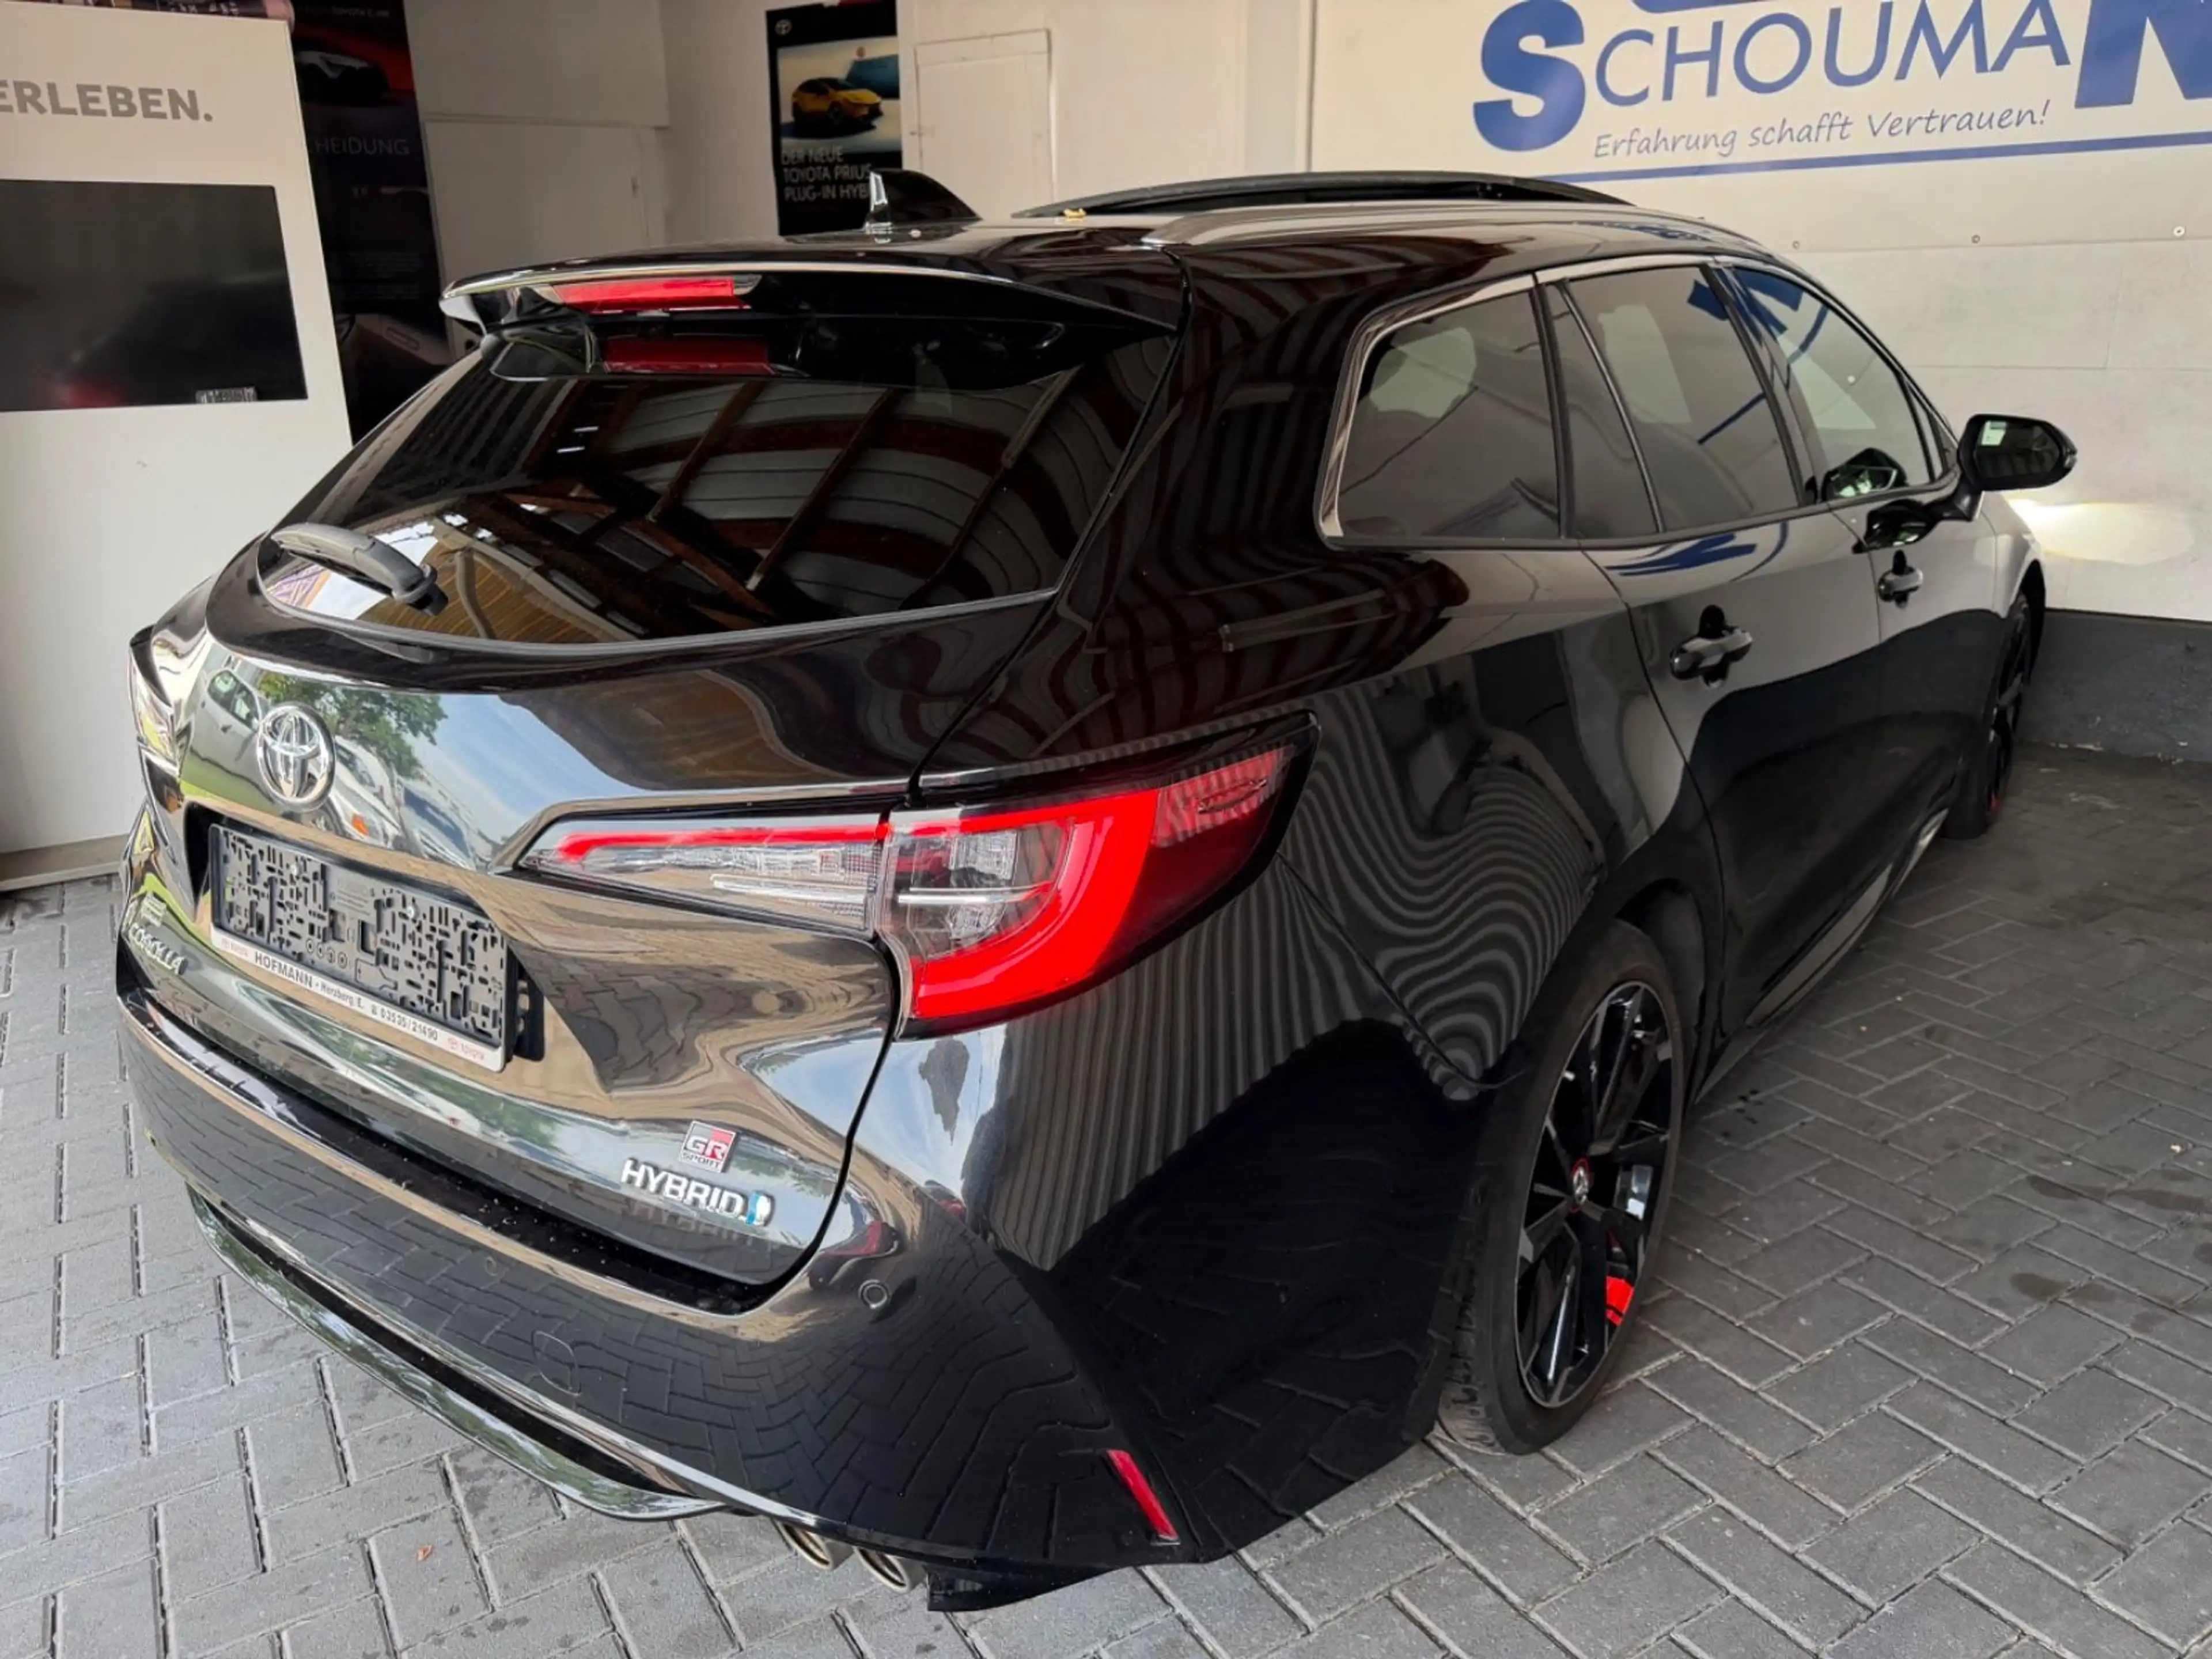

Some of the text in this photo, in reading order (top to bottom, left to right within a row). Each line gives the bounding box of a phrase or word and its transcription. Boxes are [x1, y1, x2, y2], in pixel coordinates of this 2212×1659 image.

[1593, 99, 2051, 159] Erfahrung schafft Vertrauen!
[781, 145, 844, 165] DER NEUE
[783, 166, 831, 183] TOYOTA
[784, 184, 837, 202] PLUG-IN
[255, 950, 313, 988] HOFMANN
[686, 1136, 727, 1159] GR
[621, 1158, 744, 1218] HYBRID
